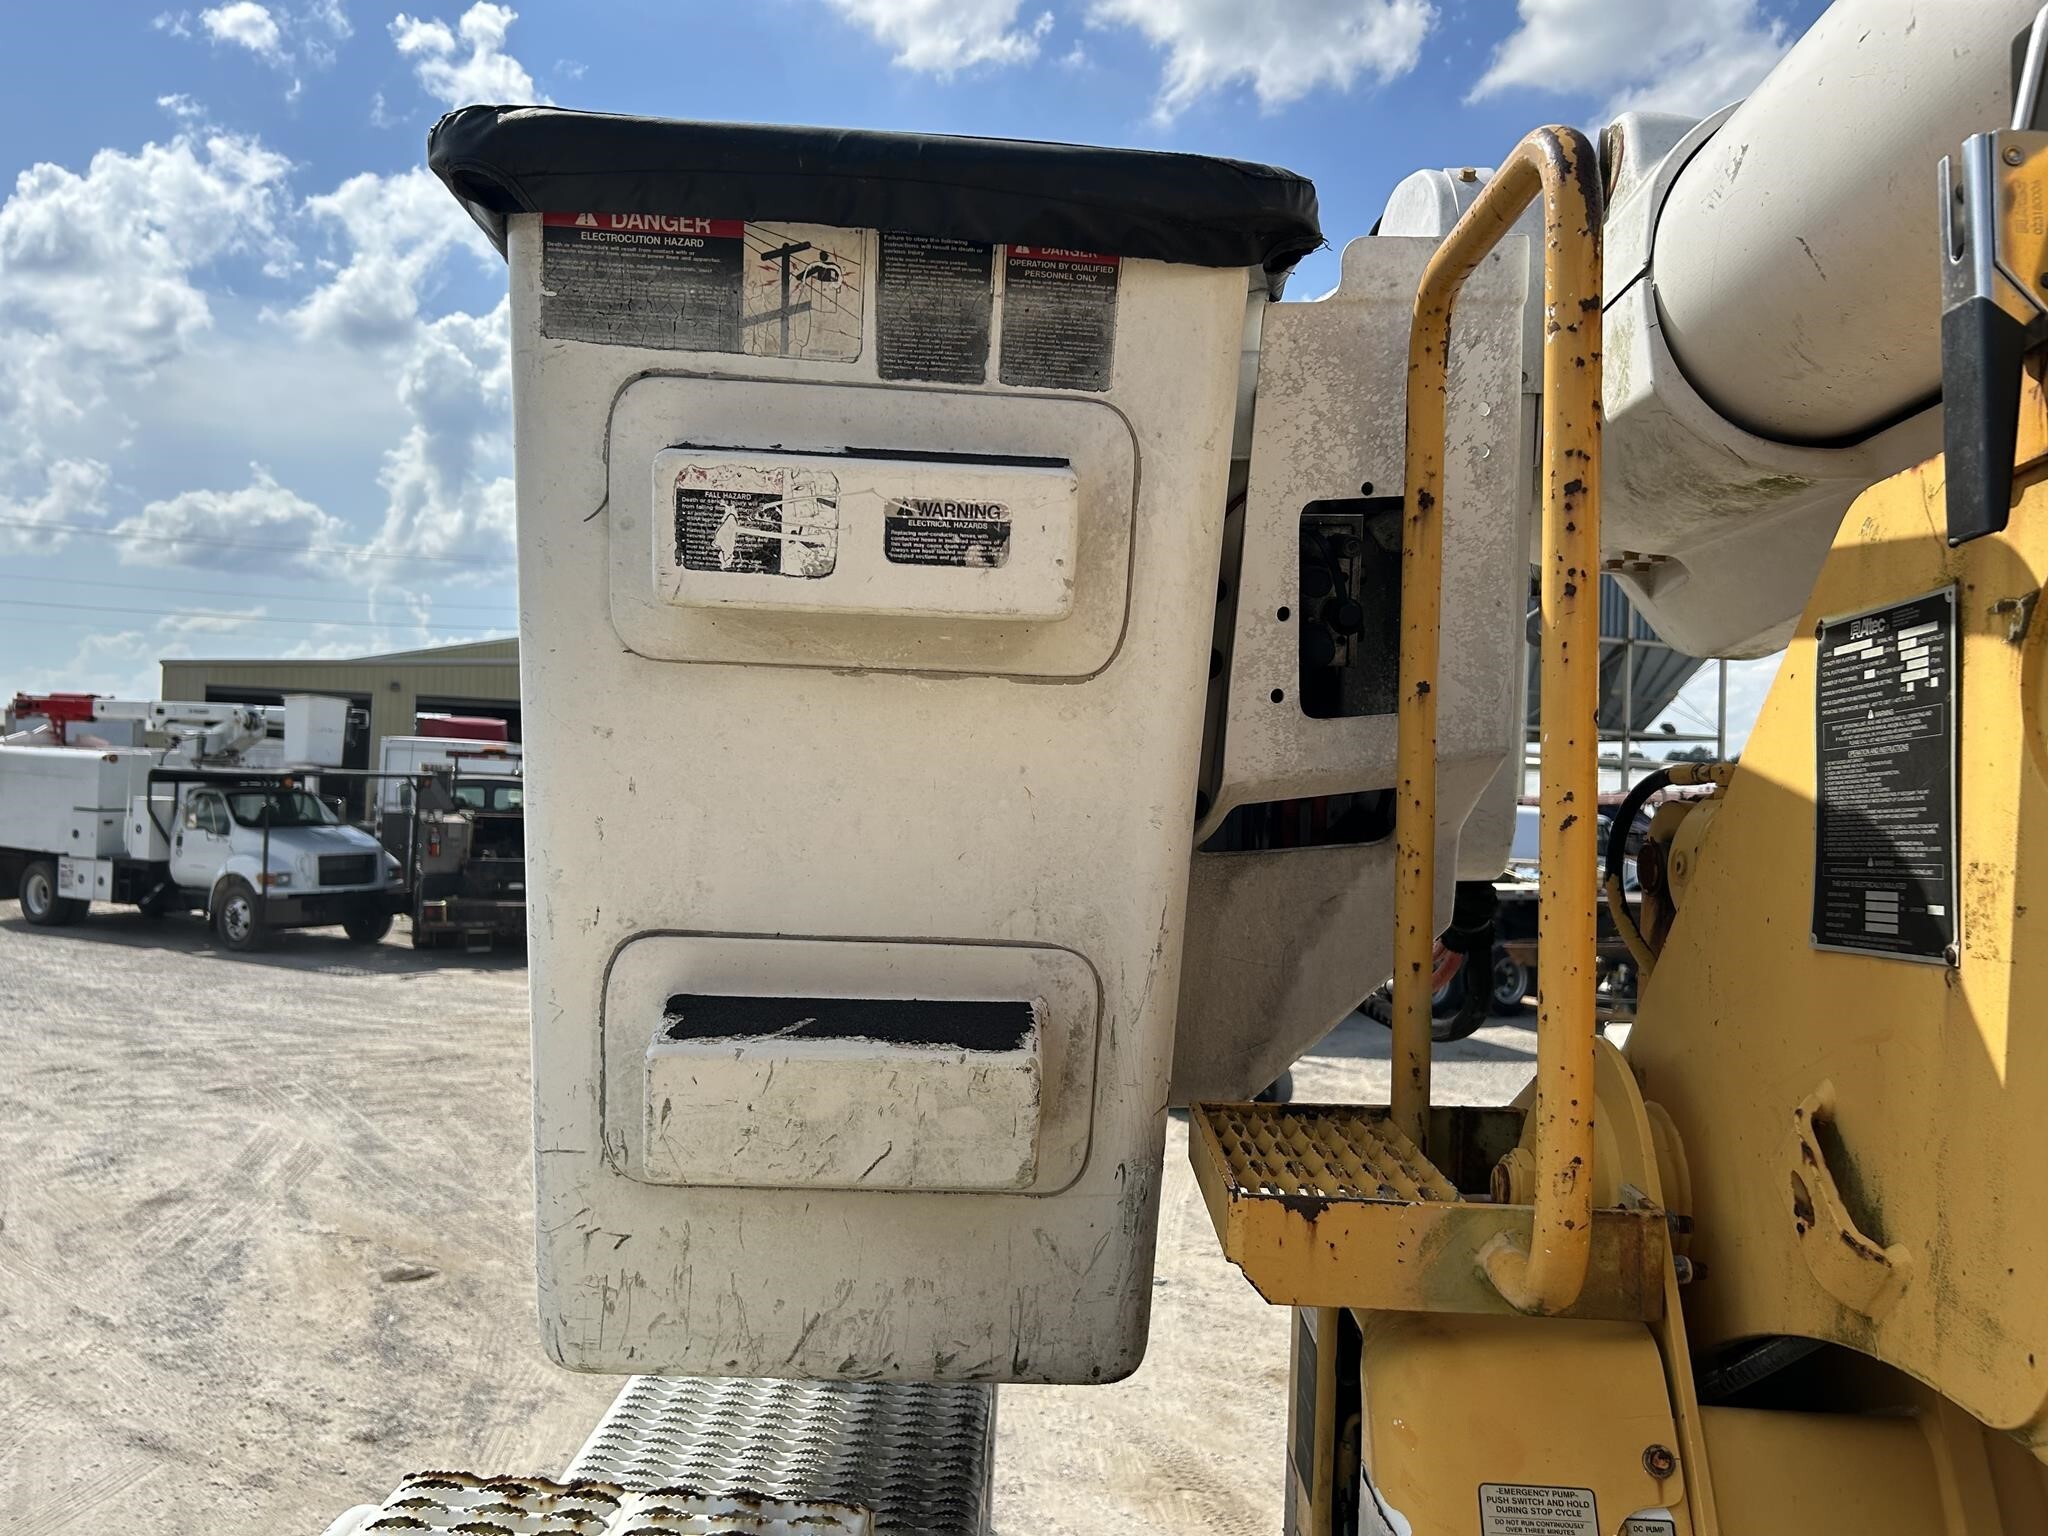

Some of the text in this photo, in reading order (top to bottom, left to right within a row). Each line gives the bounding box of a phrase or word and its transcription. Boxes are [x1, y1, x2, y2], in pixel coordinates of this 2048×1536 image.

[611, 214, 710, 233] DANGER
[581, 231, 703, 248] ELECTROCUTION HAZARD
[1009, 258, 1055, 269] OPERATION
[1071, 263, 1113, 273] QUALIFIED
[1024, 270, 1097, 282] PERSONNEL ONLY
[917, 501, 1000, 521] WARNING
[908, 520, 950, 528] ELECTRICAL
[1861, 618, 1886, 637] Altec
[1511, 1498, 1543, 1506] SWITCH
[1496, 1506, 1527, 1514] DURING
